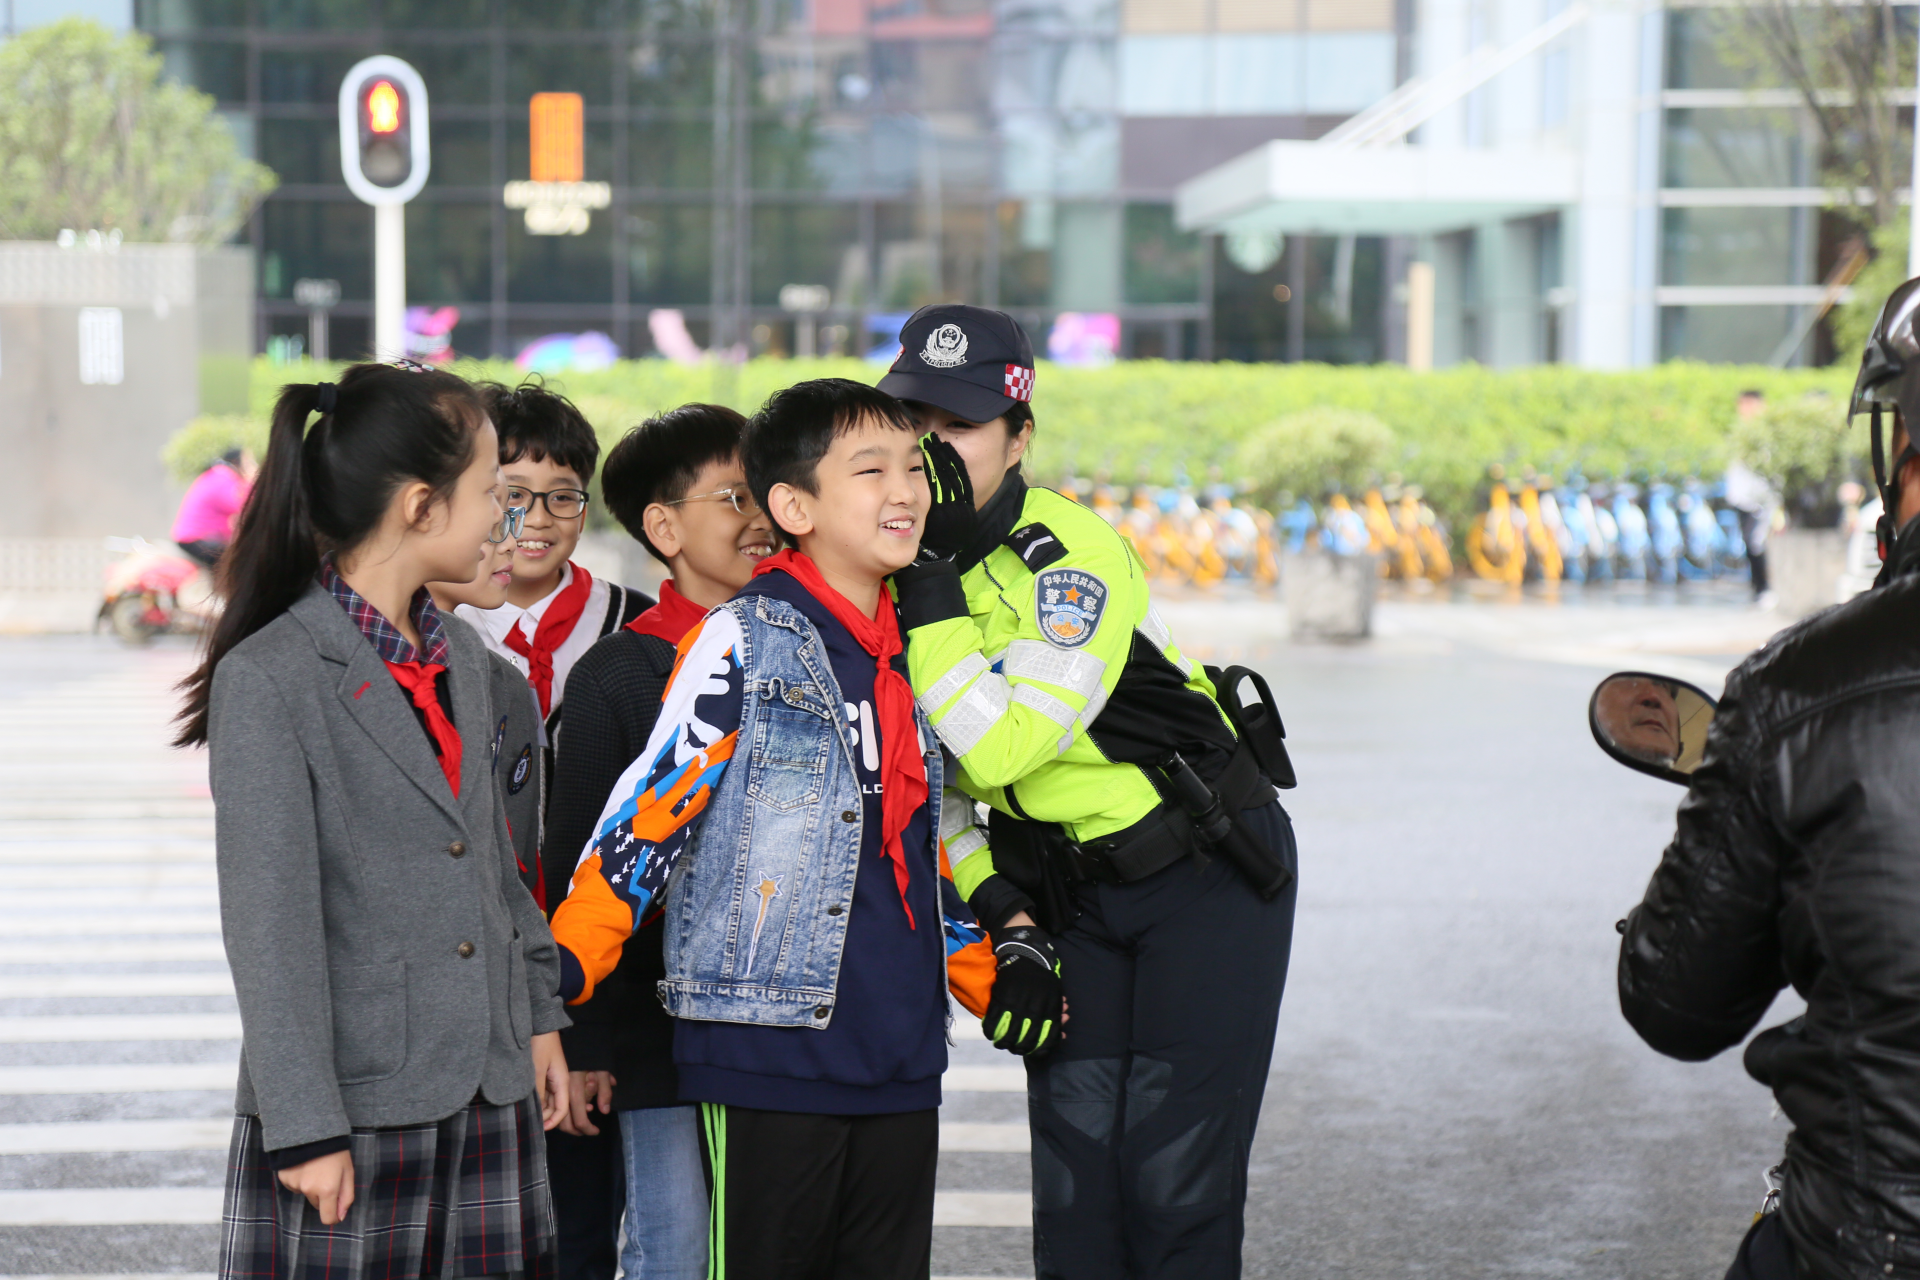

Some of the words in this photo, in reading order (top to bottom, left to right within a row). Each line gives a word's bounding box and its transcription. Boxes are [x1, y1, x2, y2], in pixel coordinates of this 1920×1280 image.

[1043, 573, 1104, 598] 中华人民共和国
[1056, 604, 1084, 617] POLICE
